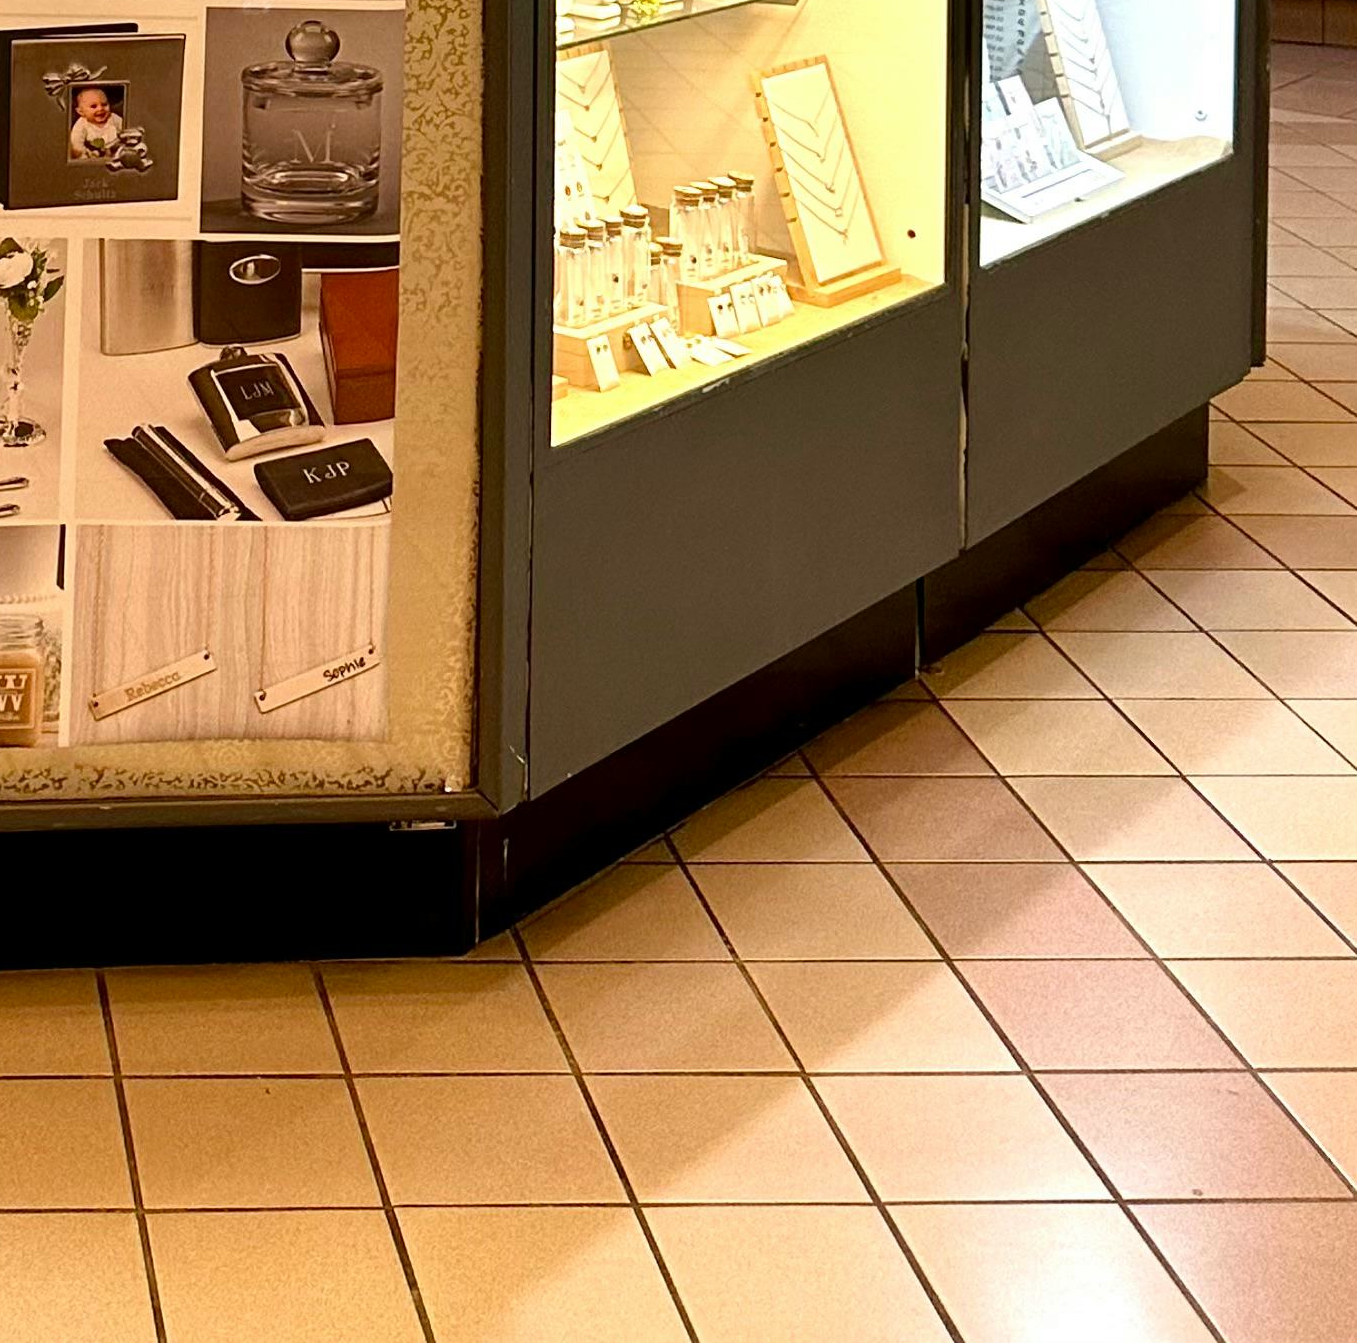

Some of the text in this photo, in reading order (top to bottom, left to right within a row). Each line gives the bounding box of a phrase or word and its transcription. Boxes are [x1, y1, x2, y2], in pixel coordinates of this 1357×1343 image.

[303, 461, 350, 484] KJP
[322, 656, 366, 683] Sophie
[124, 671, 181, 702] Rebecca
